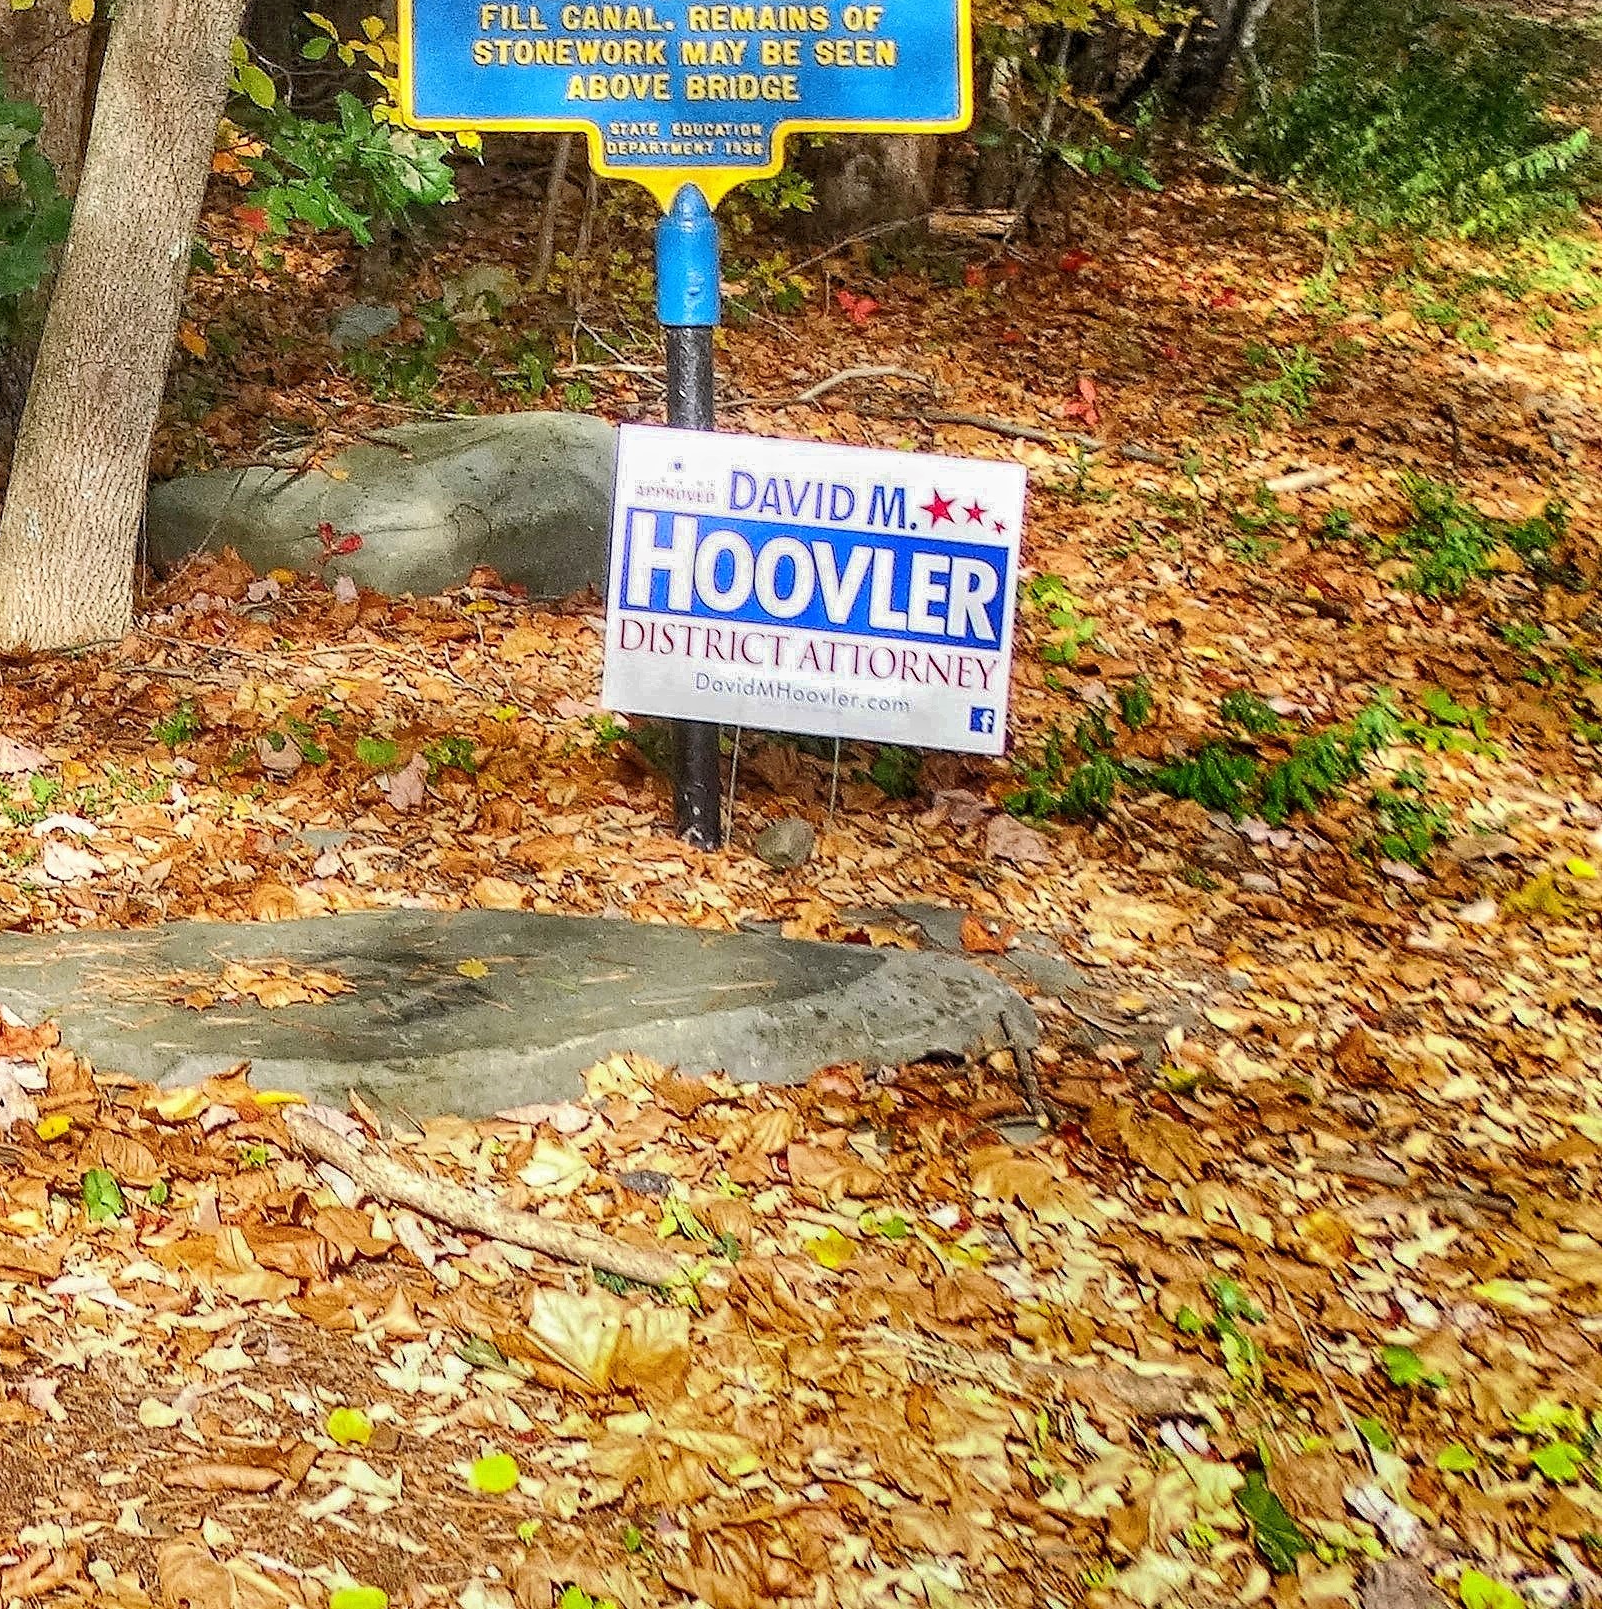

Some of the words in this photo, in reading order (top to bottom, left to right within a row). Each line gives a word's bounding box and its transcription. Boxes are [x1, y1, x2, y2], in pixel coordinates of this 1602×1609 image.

[481, 6, 547, 31] FILL
[562, 6, 676, 32] CANAL.
[688, 5, 829, 32] REMAINS
[842, 5, 884, 31] OF
[473, 41, 666, 66] STONEWORK
[680, 40, 745, 67] MAY
[762, 40, 800, 66] BE
[813, 39, 897, 66] SEEN
[566, 75, 672, 101] ABOVE
[686, 74, 801, 101] BRIDGE
[609, 122, 659, 137] STATE
[671, 122, 763, 137] EDUCATION
[606, 141, 715, 155] DEPARTMENT
[727, 469, 856, 522] DAVID
[866, 484, 918, 531] M.
[624, 509, 1000, 642] HOOVLER
[618, 618, 791, 668] DISTRICT
[798, 639, 1001, 691] ATTORNEY
[694, 672, 912, 713] DavidMHoovler.com
